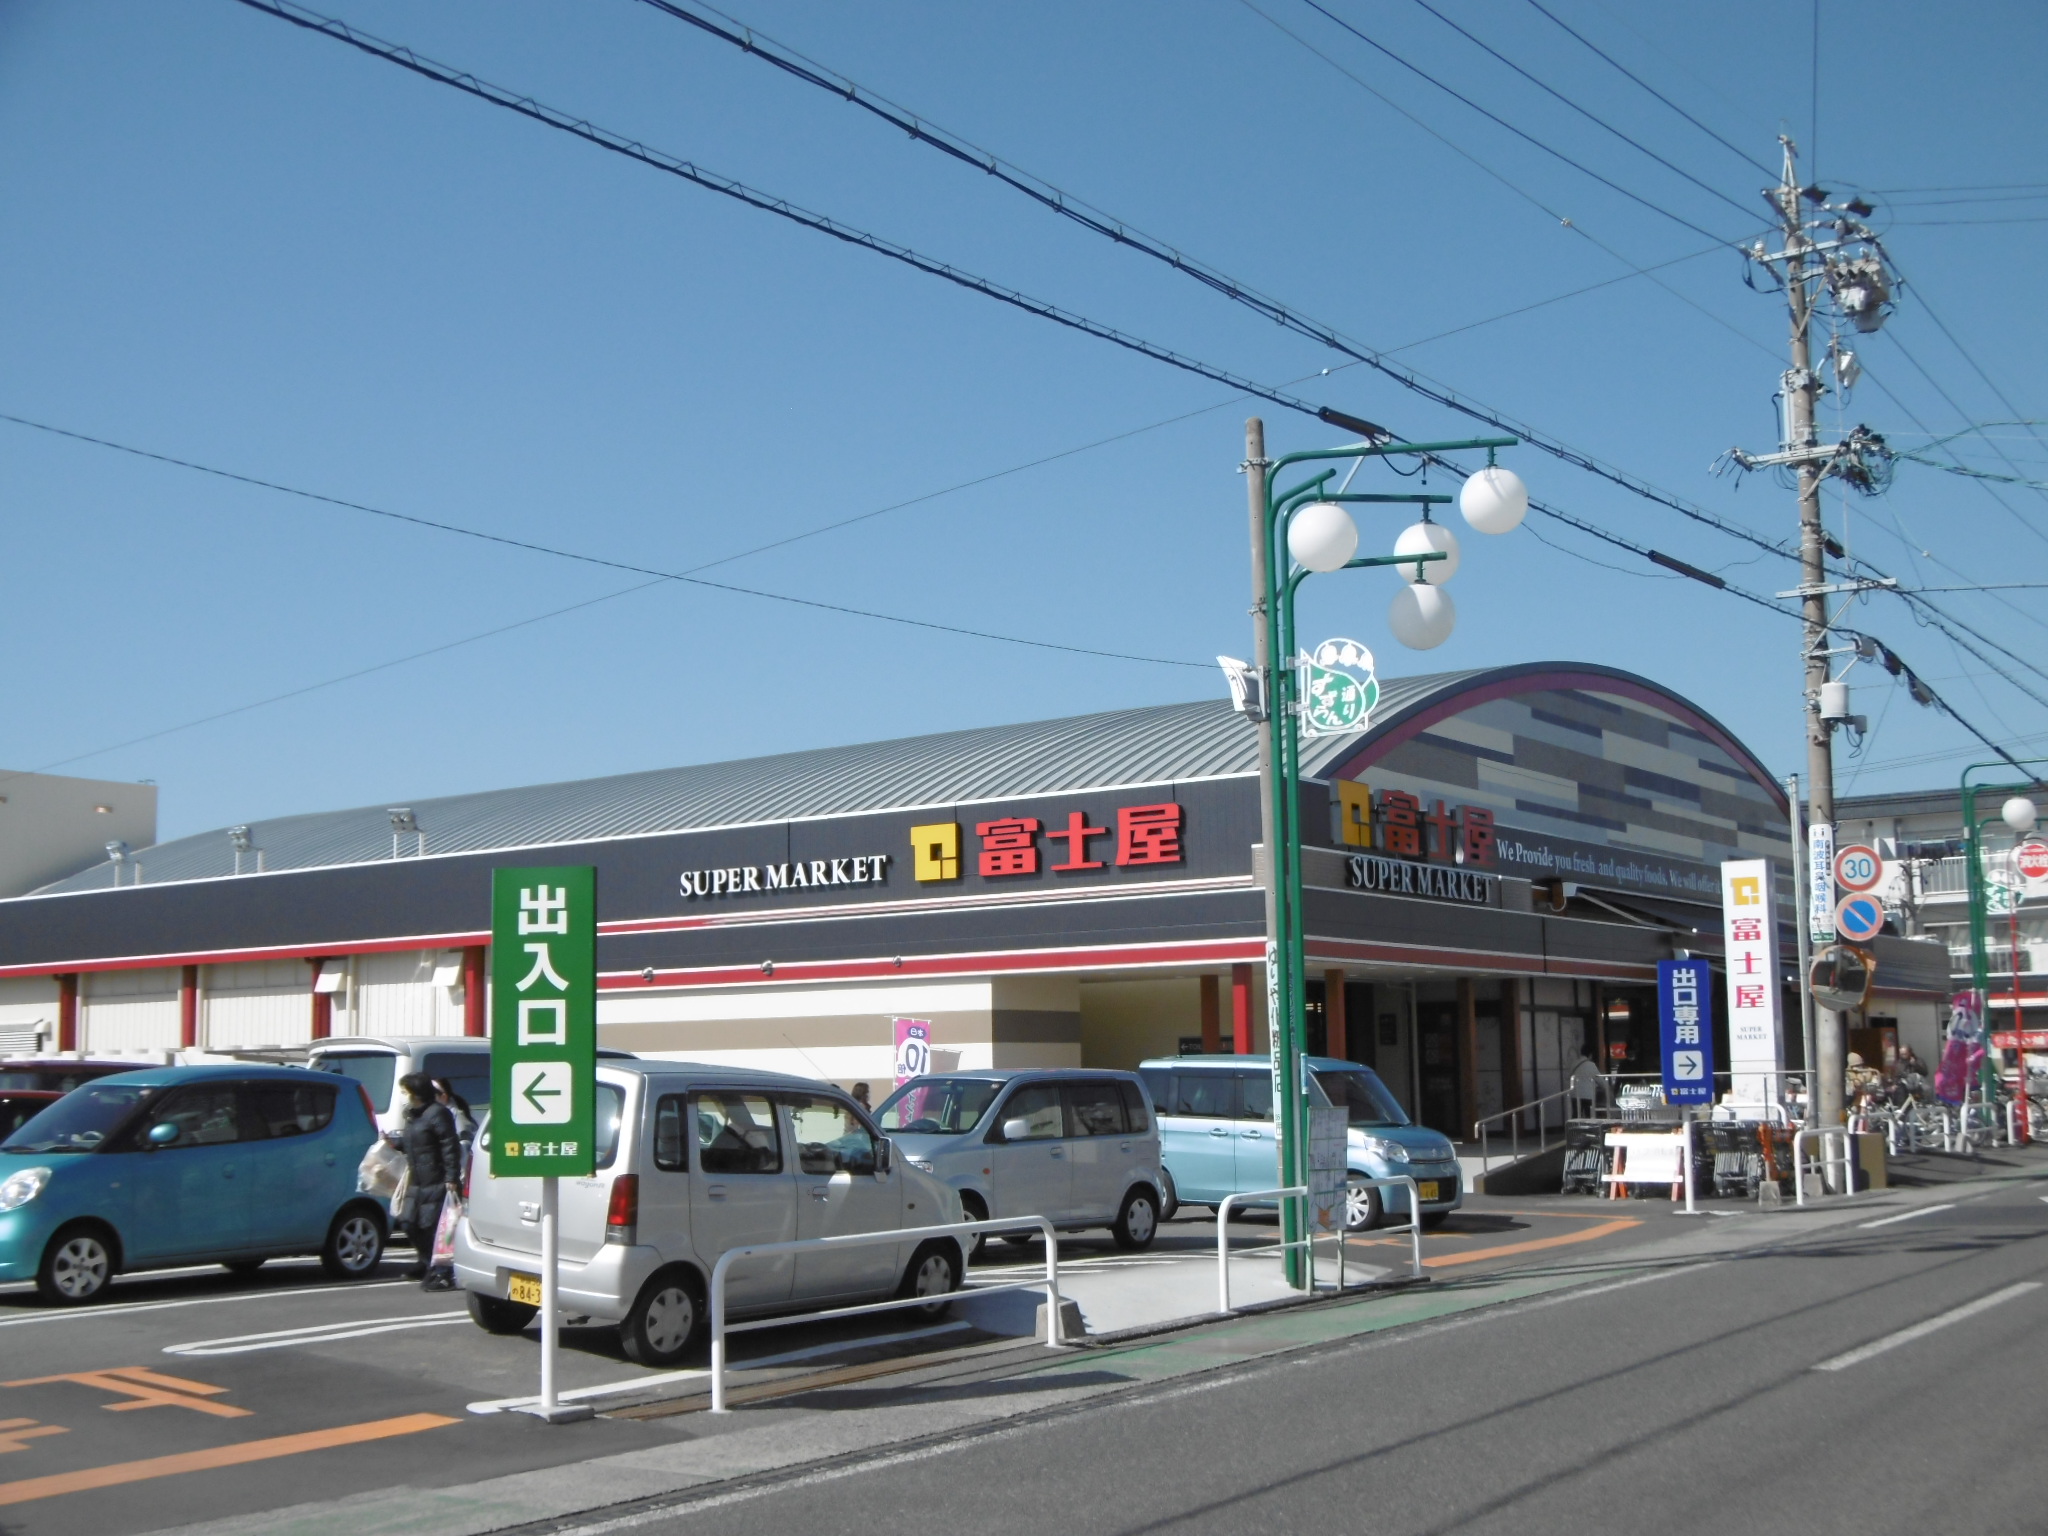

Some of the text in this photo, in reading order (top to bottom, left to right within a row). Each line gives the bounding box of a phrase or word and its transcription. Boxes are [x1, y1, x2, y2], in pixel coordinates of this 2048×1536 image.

[975, 802, 1182, 877] 富士屋
[1380, 789, 1495, 866] 富士屋
[680, 854, 886, 897] SUPER MARKET
[1350, 856, 1492, 902] SUPER MARKET
[1496, 838, 1514, 861] We
[1515, 842, 1553, 867] Provide
[1555, 855, 1571, 874] you
[1573, 851, 1595, 874] fresh
[1598, 858, 1614, 877] and
[1615, 861, 1644, 887] quality
[1669, 868, 1682, 888] We
[1845, 858, 1871, 879] 30
[515, 885, 569, 1046] 出入口
[1731, 918, 1764, 1008] 富士屋
[1672, 967, 1699, 1044] 出口専用
[1680, 1087, 1707, 1095] 富士屋
[523, 1142, 578, 1156] 富士屋
[520, 1286, 541, 1303] 84-3
